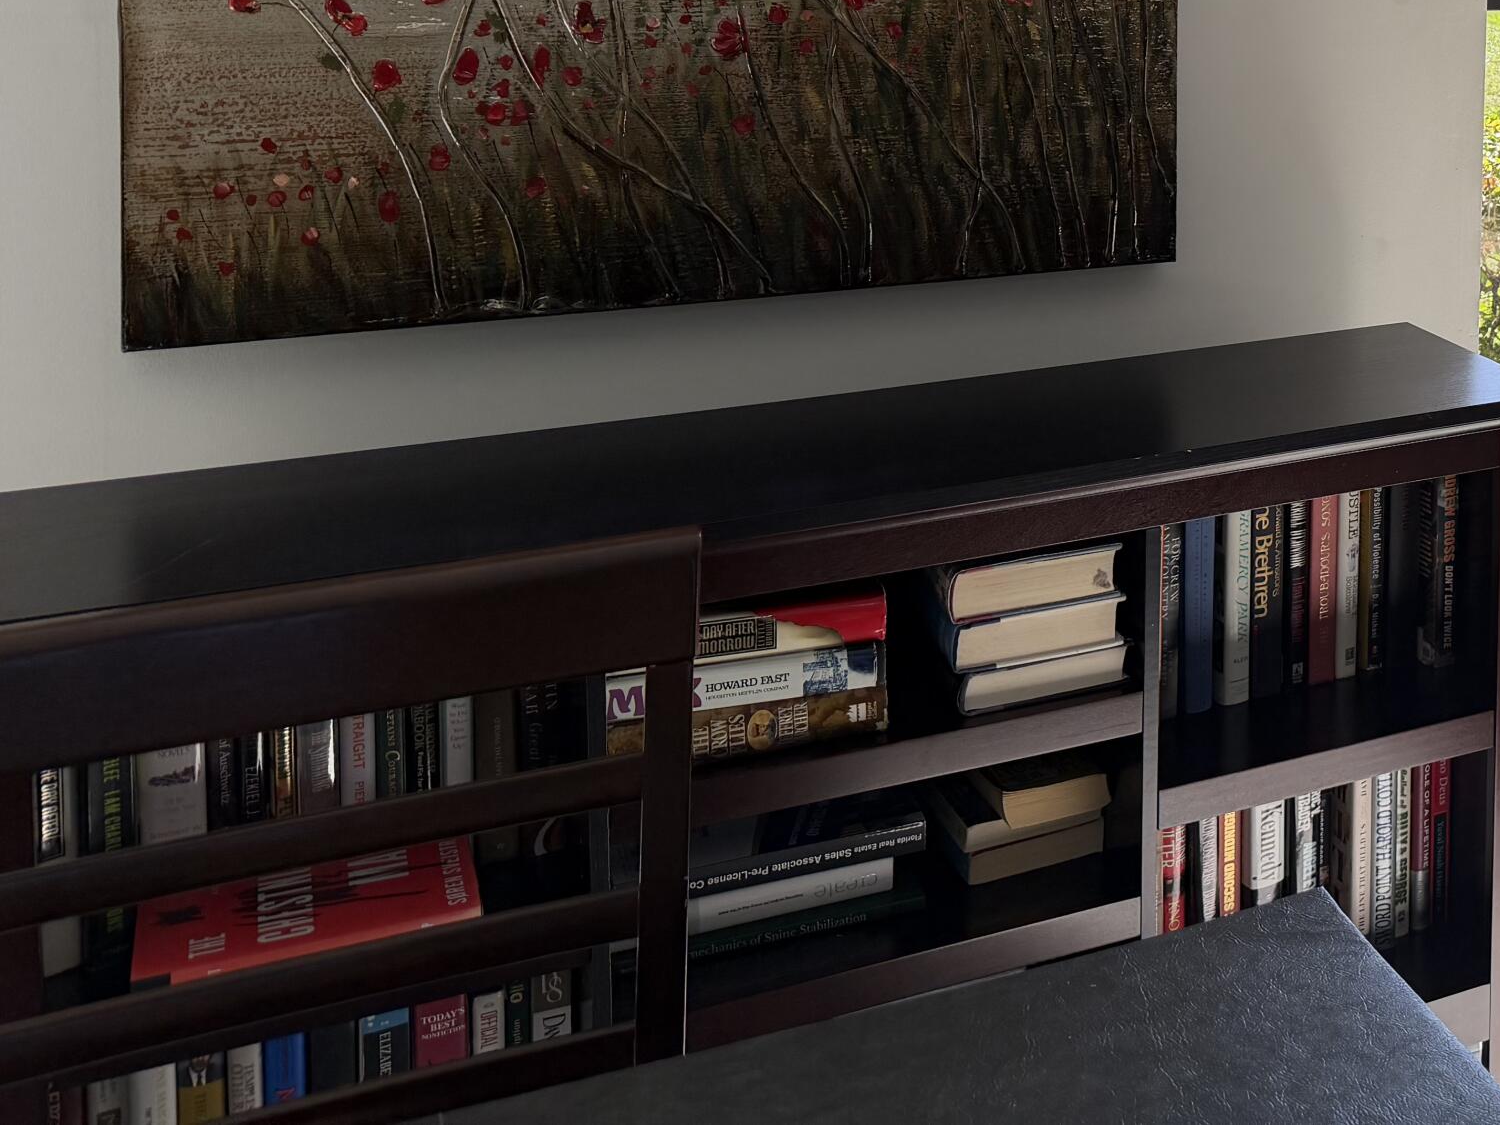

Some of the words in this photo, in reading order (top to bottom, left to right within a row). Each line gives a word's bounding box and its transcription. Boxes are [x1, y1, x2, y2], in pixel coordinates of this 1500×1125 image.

[1372, 487, 1384, 531] Possibility
[1170, 536, 1181, 560] FOR
[1372, 532, 1381, 542] of
[1443, 519, 1456, 563] GROSS
[1272, 548, 1284, 598] Armstrong
[1372, 542, 1382, 579] Violence
[1169, 561, 1180, 603] CREW
[1254, 534, 1274, 620] Brethren
[1319, 532, 1331, 620] TROUBADOUR'S
[1442, 594, 1454, 618] LOOK
[702, 625, 724, 640] DAY
[725, 620, 756, 638] AFTER
[1236, 601, 1249, 644] PARK
[1442, 619, 1454, 650] TWICE
[705, 677, 758, 693] HOWARD
[760, 672, 790, 686] FAST
[218, 738, 231, 749] of
[219, 750, 233, 806] Auschwitz
[1439, 776, 1448, 806] Deus
[1424, 790, 1431, 805] OF
[853, 843, 879, 855] Estate
[878, 839, 896, 851] Real
[898, 832, 923, 846] Florida
[1260, 803, 1282, 881] Kennedy
[1375, 810, 1393, 862] HAROLD
[1423, 818, 1432, 868] LIFETIME
[771, 855, 822, 873] Associate
[825, 848, 852, 862] Sales
[708, 866, 769, 886] Pre-License
[1223, 862, 1236, 912] SECOND
[1375, 864, 1392, 902] POINT
[750, 933, 763, 947] of
[763, 926, 798, 947] Spine
[799, 912, 868, 934] Stabilization
[188, 932, 226, 960] THE
[420, 1006, 465, 1024] TODAY'S
[430, 1017, 457, 1032] BEST
[480, 1009, 499, 1049] OFFICIAL
[420, 1025, 466, 1041] NONFICTION
